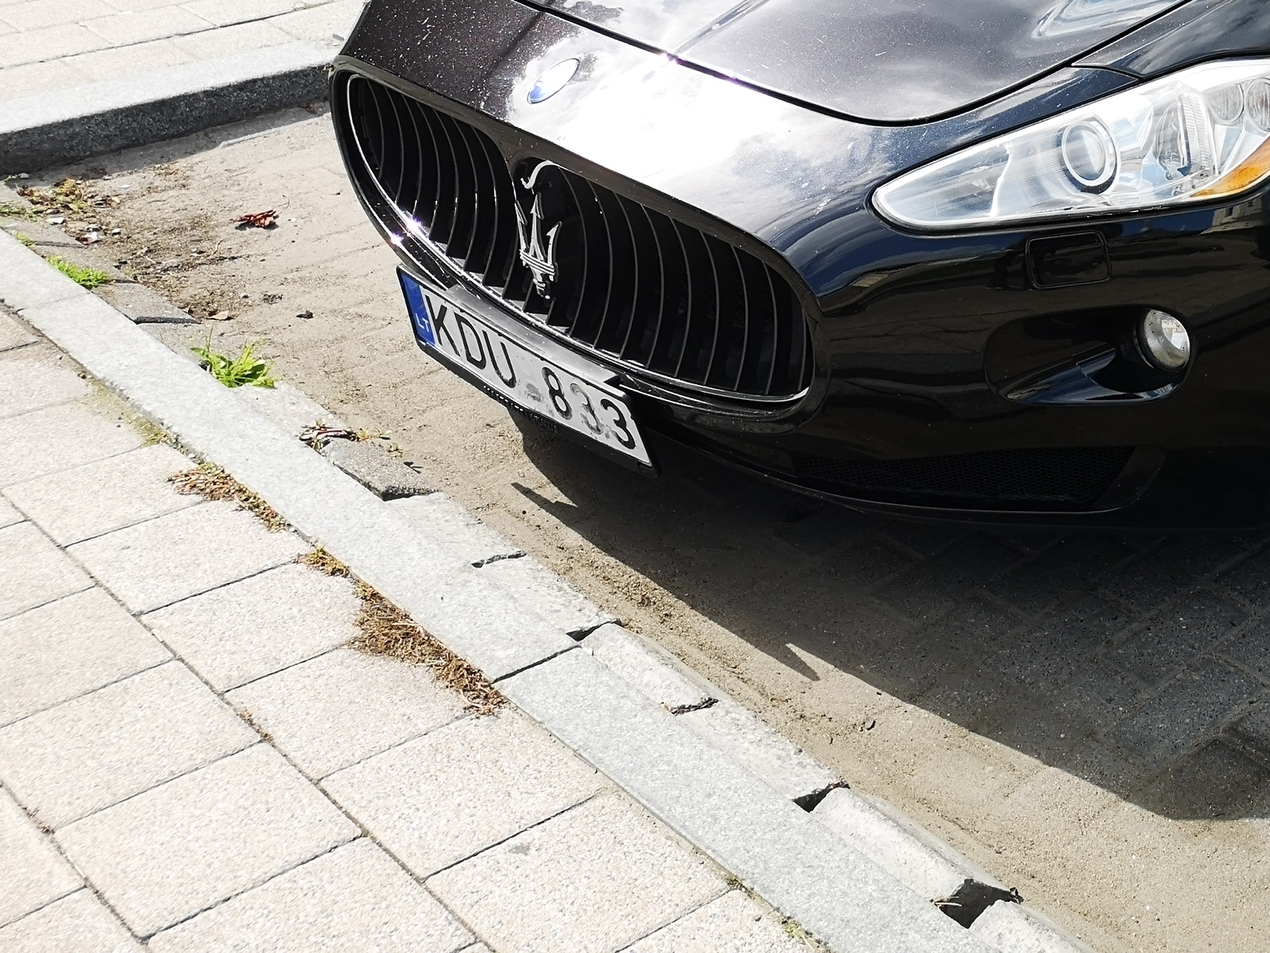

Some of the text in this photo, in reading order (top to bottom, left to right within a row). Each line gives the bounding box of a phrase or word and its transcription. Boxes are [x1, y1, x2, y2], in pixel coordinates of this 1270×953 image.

[416, 312, 430, 333] LT
[425, 295, 518, 389] KDU
[541, 366, 637, 450] 833
